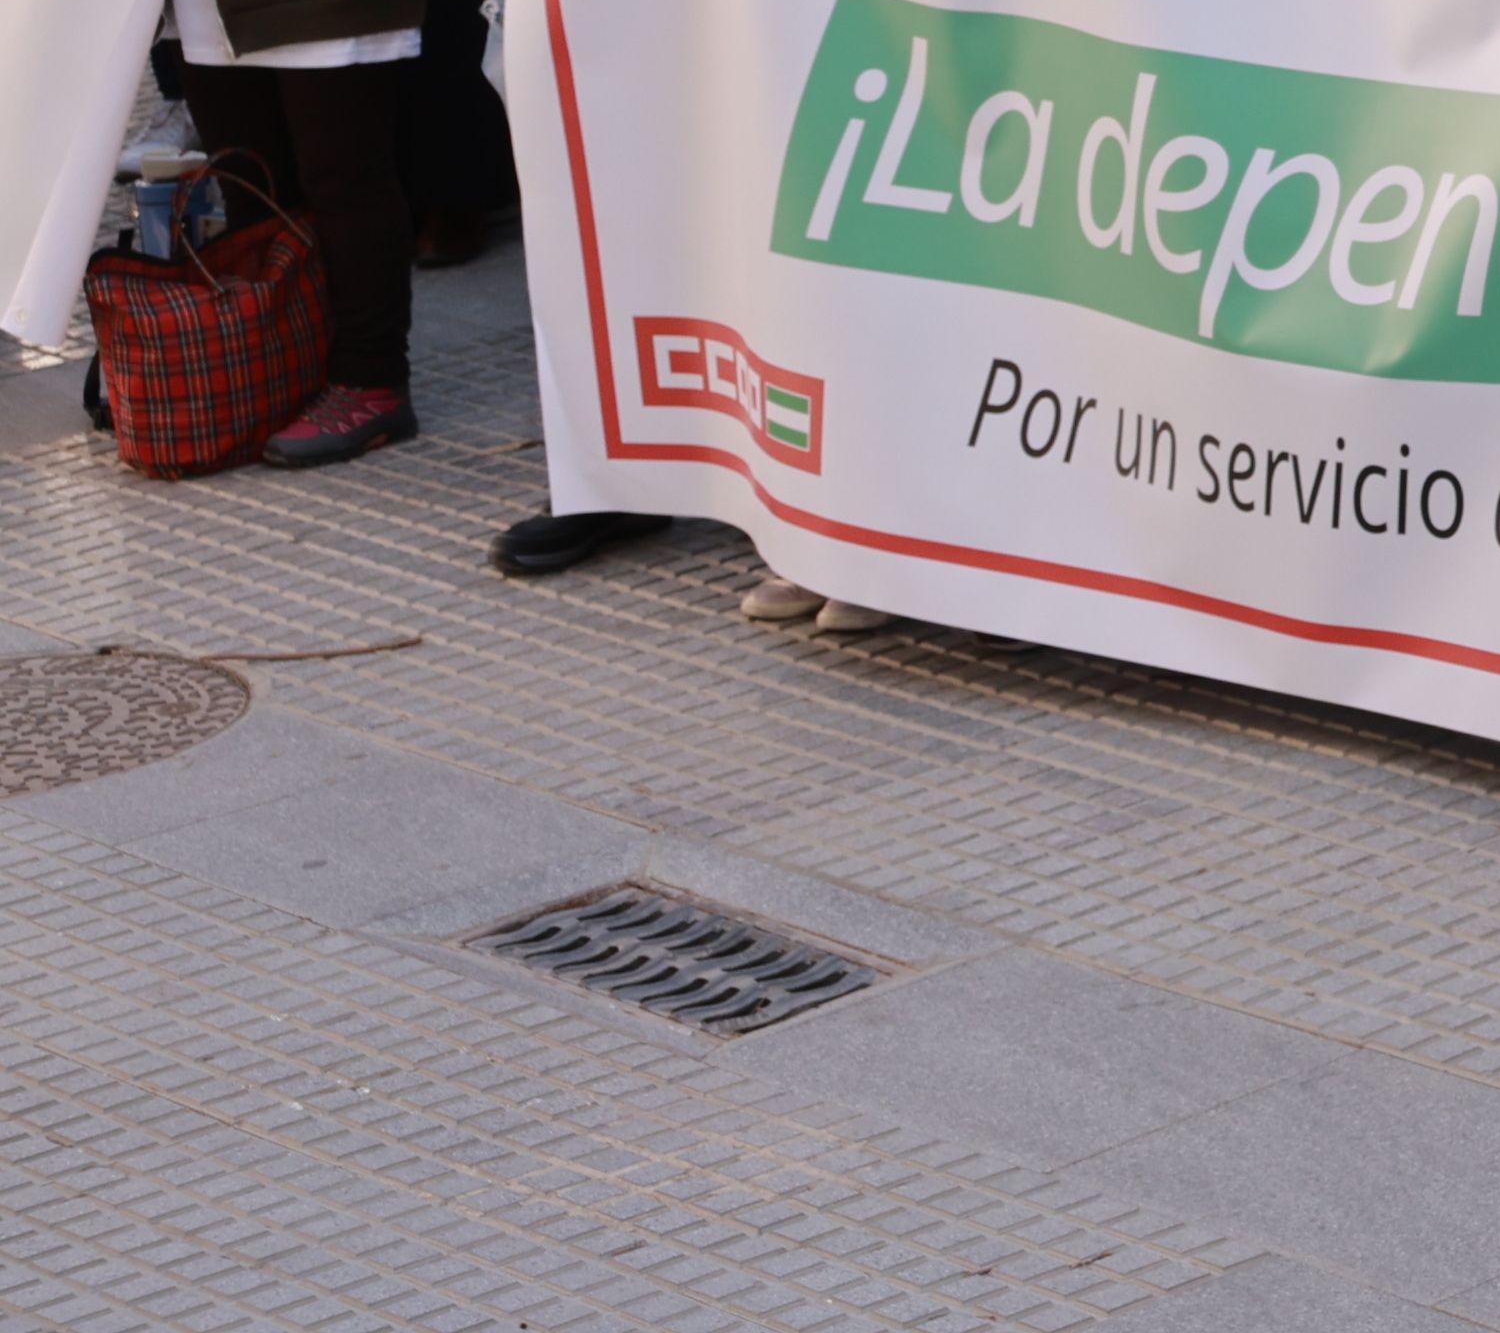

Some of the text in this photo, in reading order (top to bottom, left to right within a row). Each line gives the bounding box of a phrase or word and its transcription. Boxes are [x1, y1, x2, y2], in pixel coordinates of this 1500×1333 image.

[806, 36, 1052, 242] ¡La
[652, 336, 762, 436] CCOO
[968, 356, 1096, 463] Por
[1113, 400, 1177, 491] un
[1198, 430, 1464, 539] servicio
